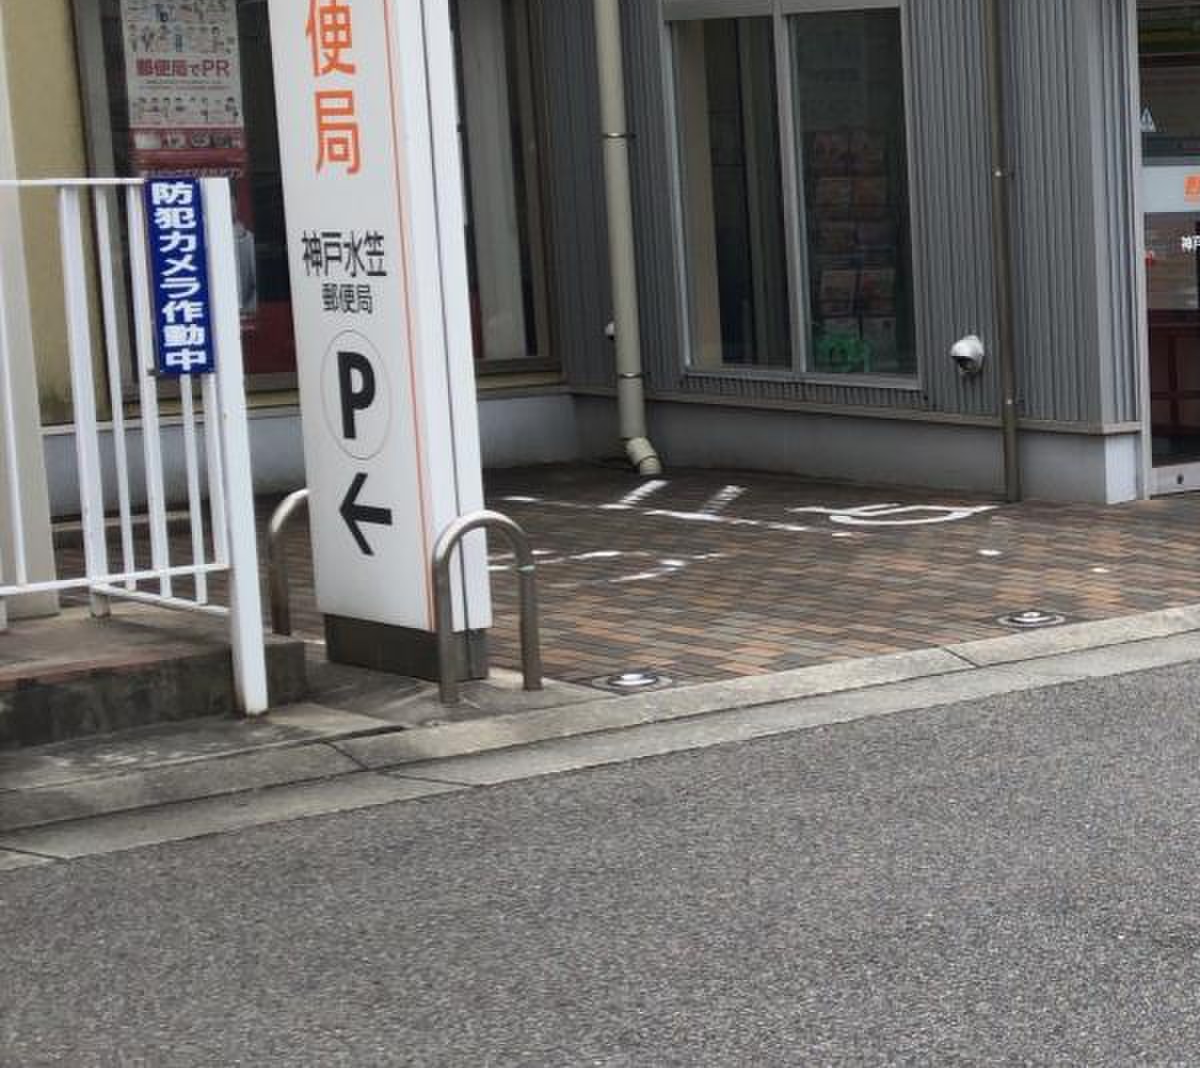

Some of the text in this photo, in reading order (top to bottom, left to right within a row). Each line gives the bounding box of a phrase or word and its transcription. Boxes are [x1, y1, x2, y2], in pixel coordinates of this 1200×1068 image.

[135, 57, 231, 79] 郵便局でPR
[150, 181, 207, 372] 防犯カメラ作動中
[301, 230, 388, 278] 神戸水笠
[321, 282, 374, 315] 郵便局
[336, 350, 377, 440] P
